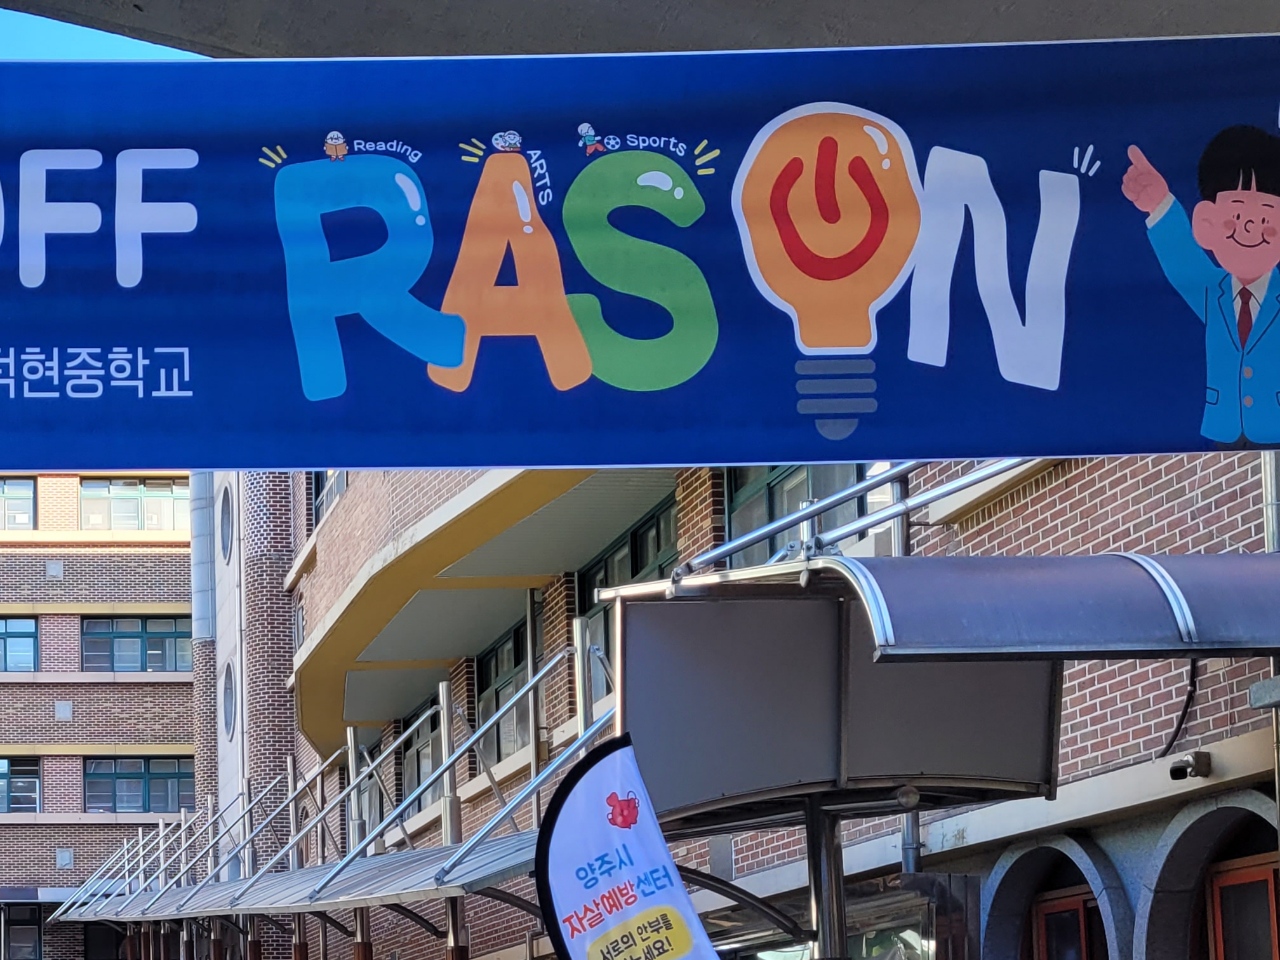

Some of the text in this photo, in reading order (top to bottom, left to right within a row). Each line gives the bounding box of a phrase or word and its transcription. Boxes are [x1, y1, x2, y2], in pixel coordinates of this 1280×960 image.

[352, 138, 423, 164] Reading
[625, 131, 689, 157] Sports
[526, 149, 554, 207] ARTS
[575, 843, 634, 890] 양주시
[562, 865, 675, 939] 자살예방센터
[636, 913, 674, 943] 안부를
